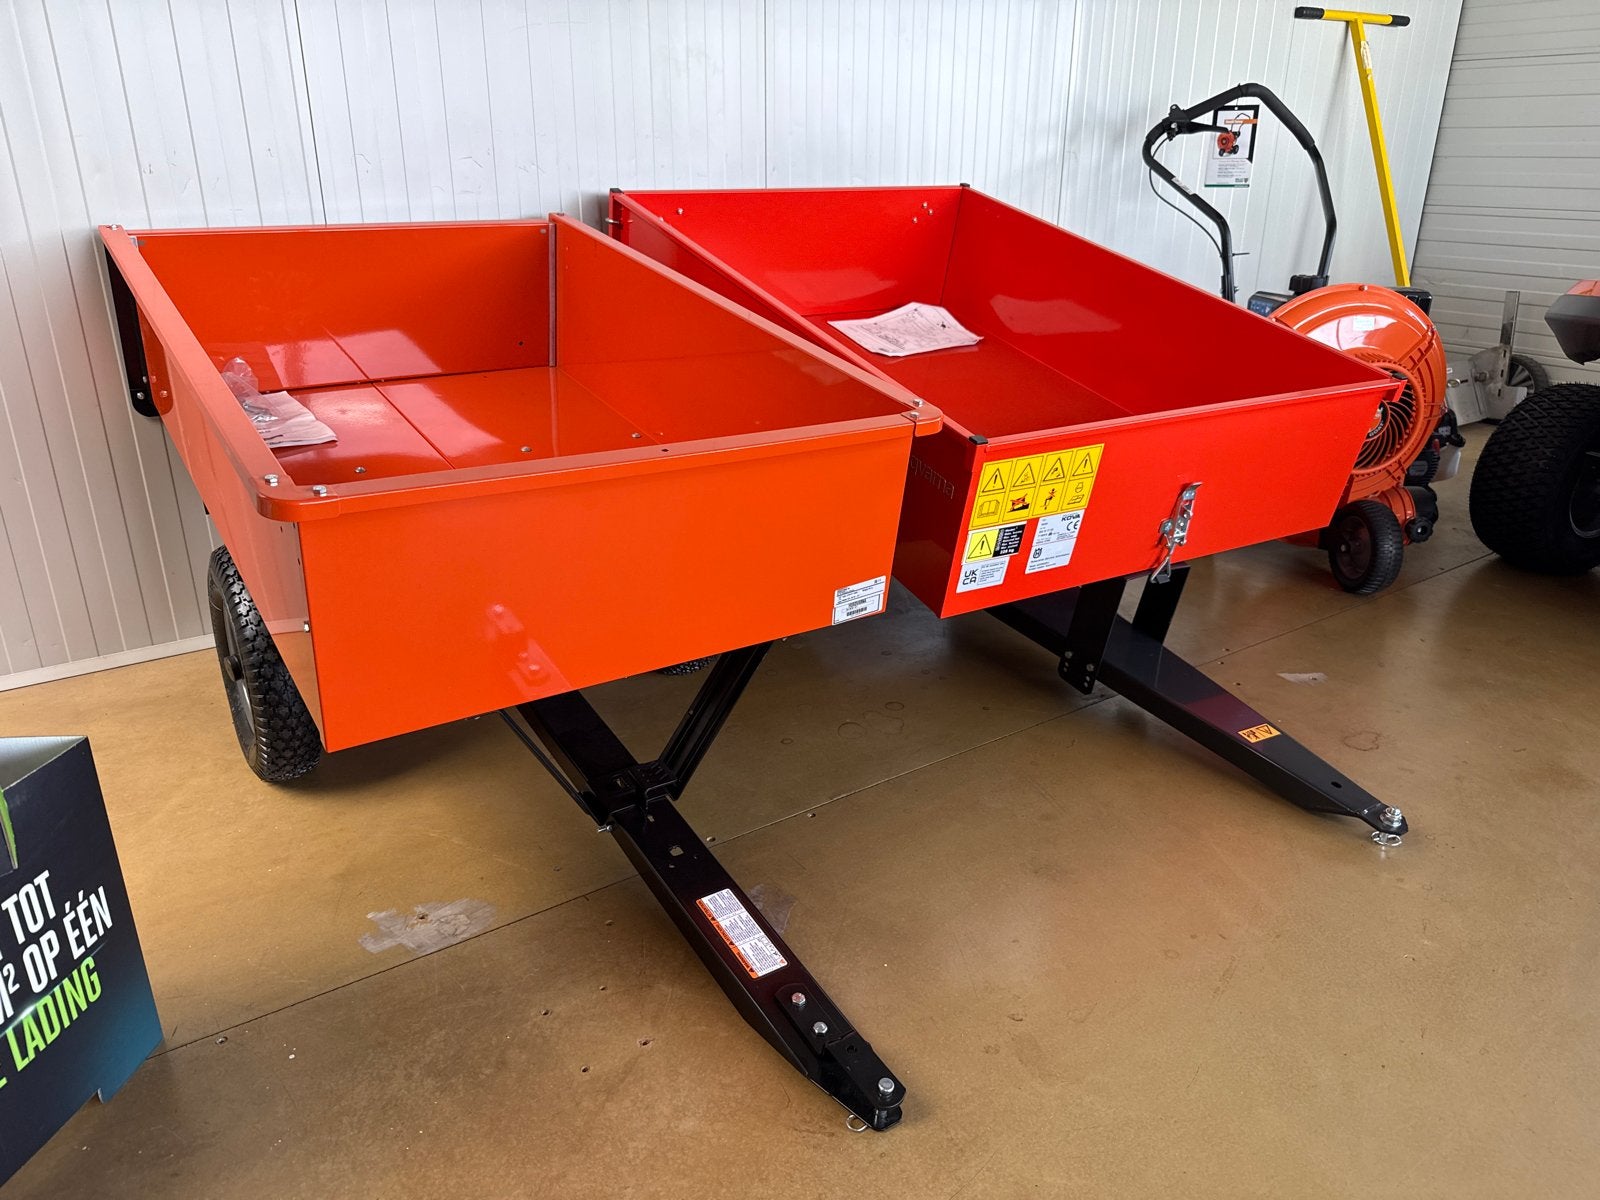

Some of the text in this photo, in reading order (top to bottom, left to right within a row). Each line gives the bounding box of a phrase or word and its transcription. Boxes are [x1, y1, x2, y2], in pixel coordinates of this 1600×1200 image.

[962, 576, 977, 586] CA
[964, 568, 979, 578] UK
[1, 870, 57, 945] TOT
[22, 929, 60, 994] OP
[62, 885, 113, 960] ÉÉN
[6, 956, 102, 1072] LADING
